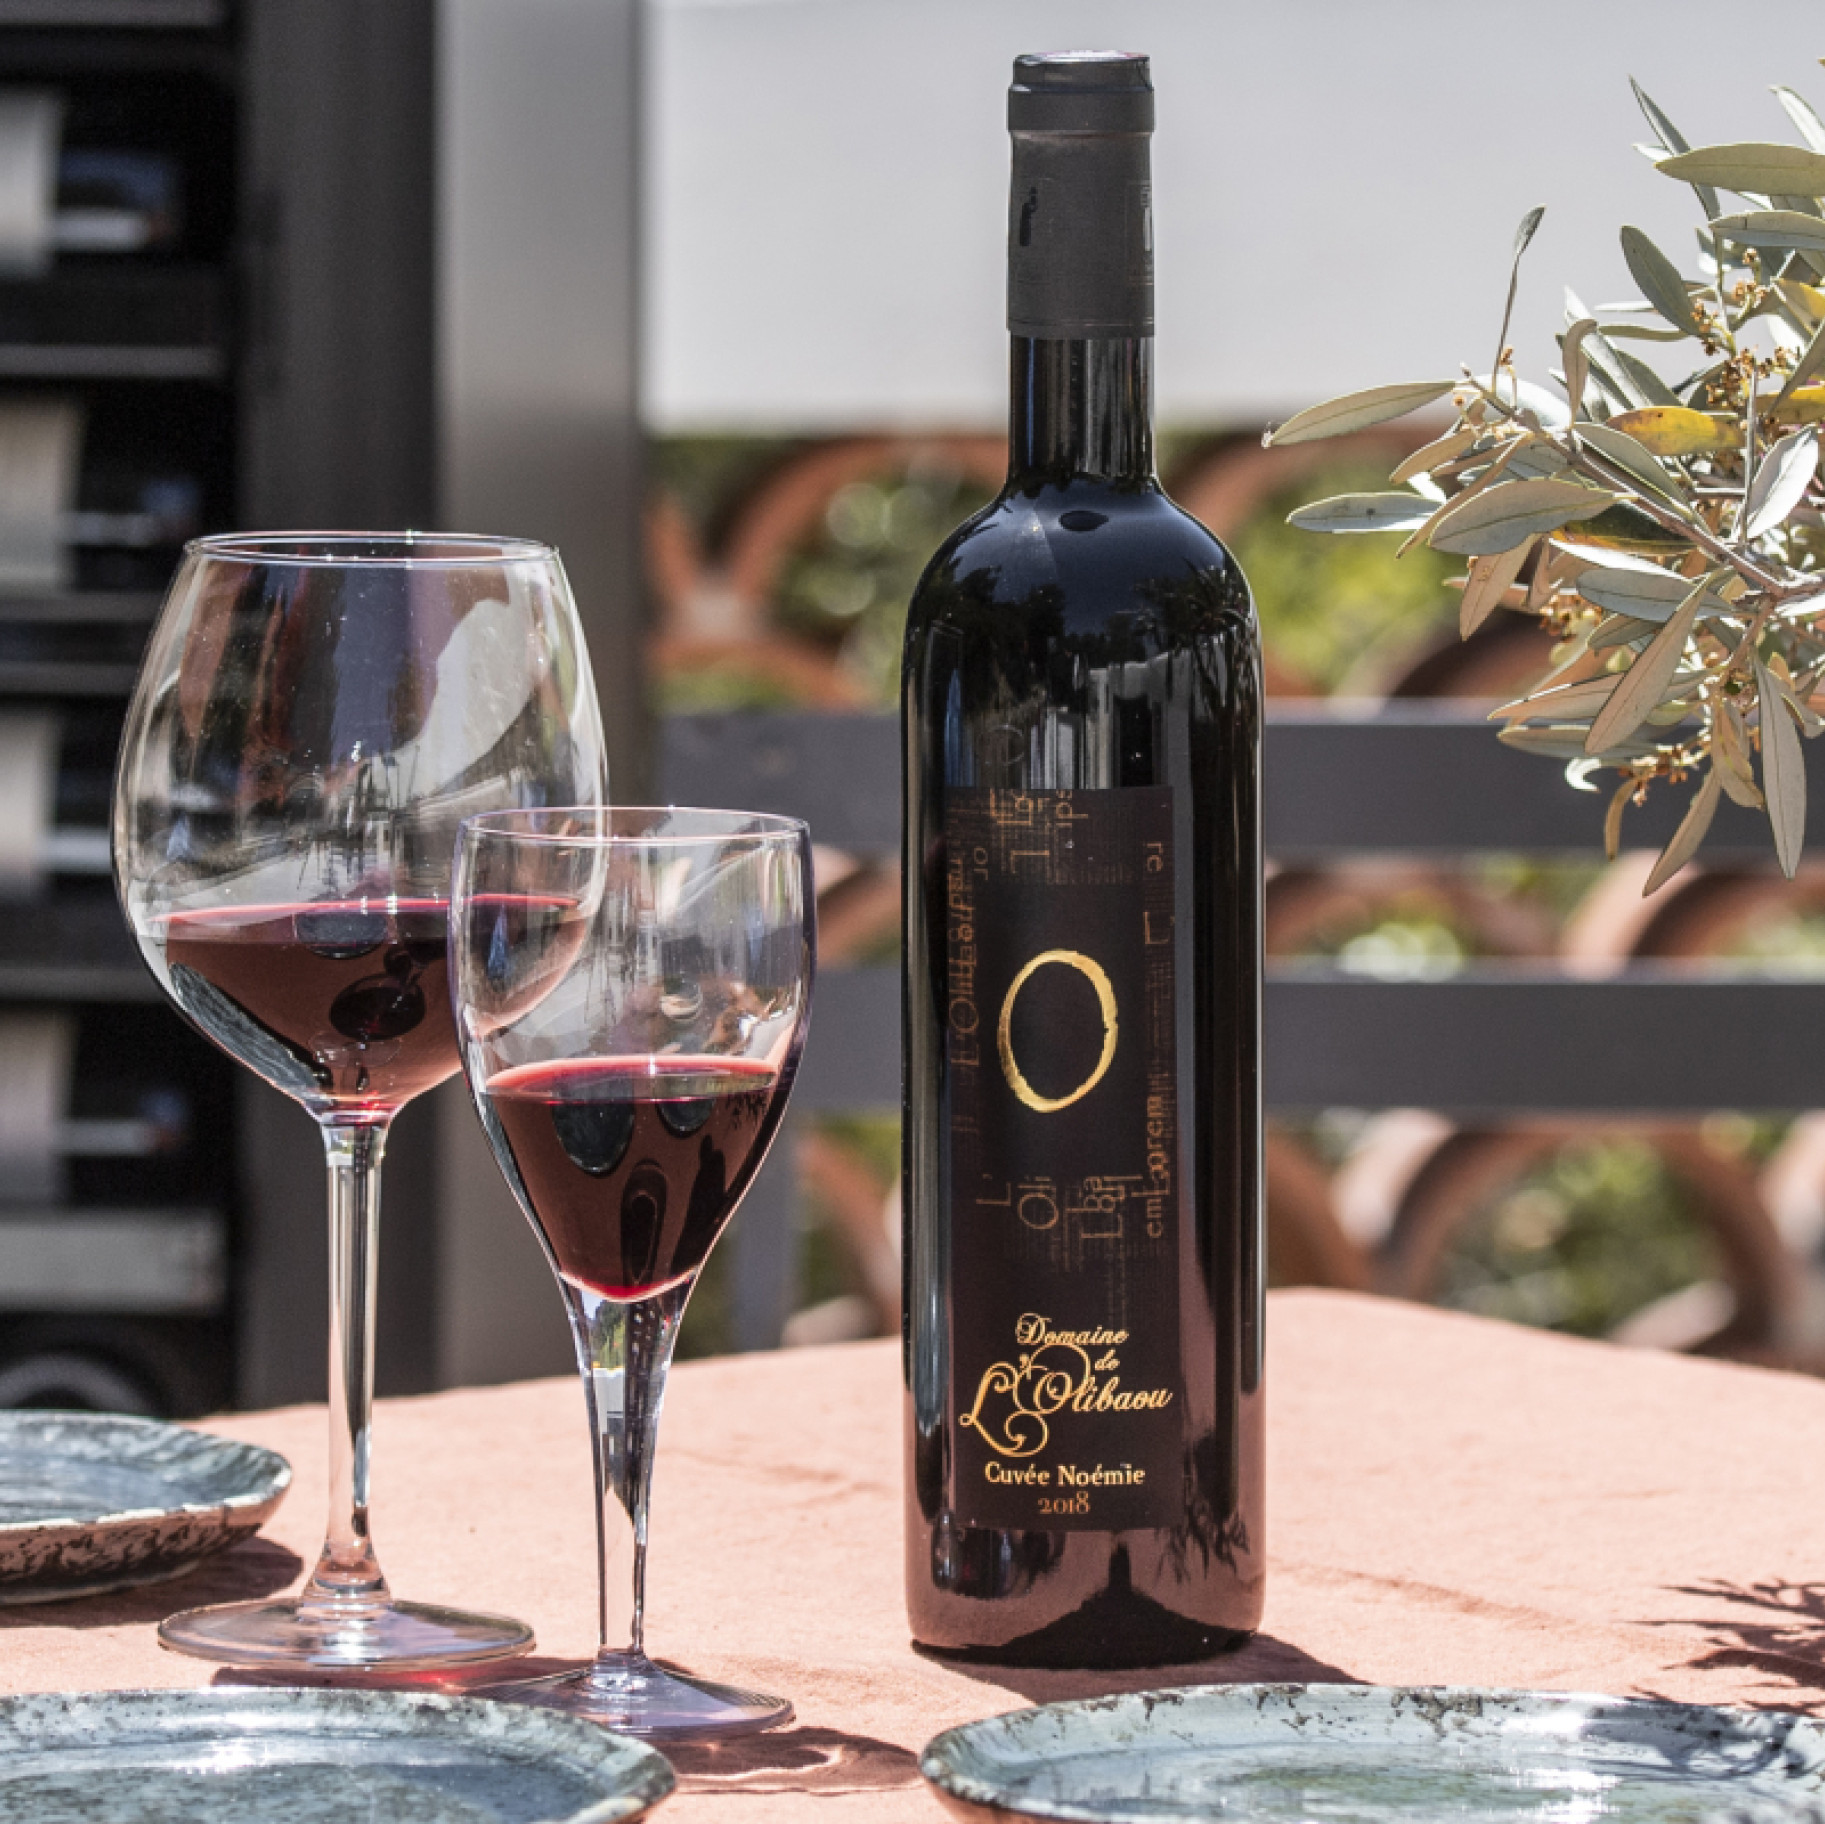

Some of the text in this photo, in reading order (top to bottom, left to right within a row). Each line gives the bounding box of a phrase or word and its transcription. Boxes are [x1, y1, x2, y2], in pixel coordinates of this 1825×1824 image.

[1014, 1312, 1130, 1346] Domaine
[1094, 1348, 1121, 1372] de
[984, 1460, 1147, 1487] Cuvée Noémie
[1037, 1490, 1091, 1515] 2018
